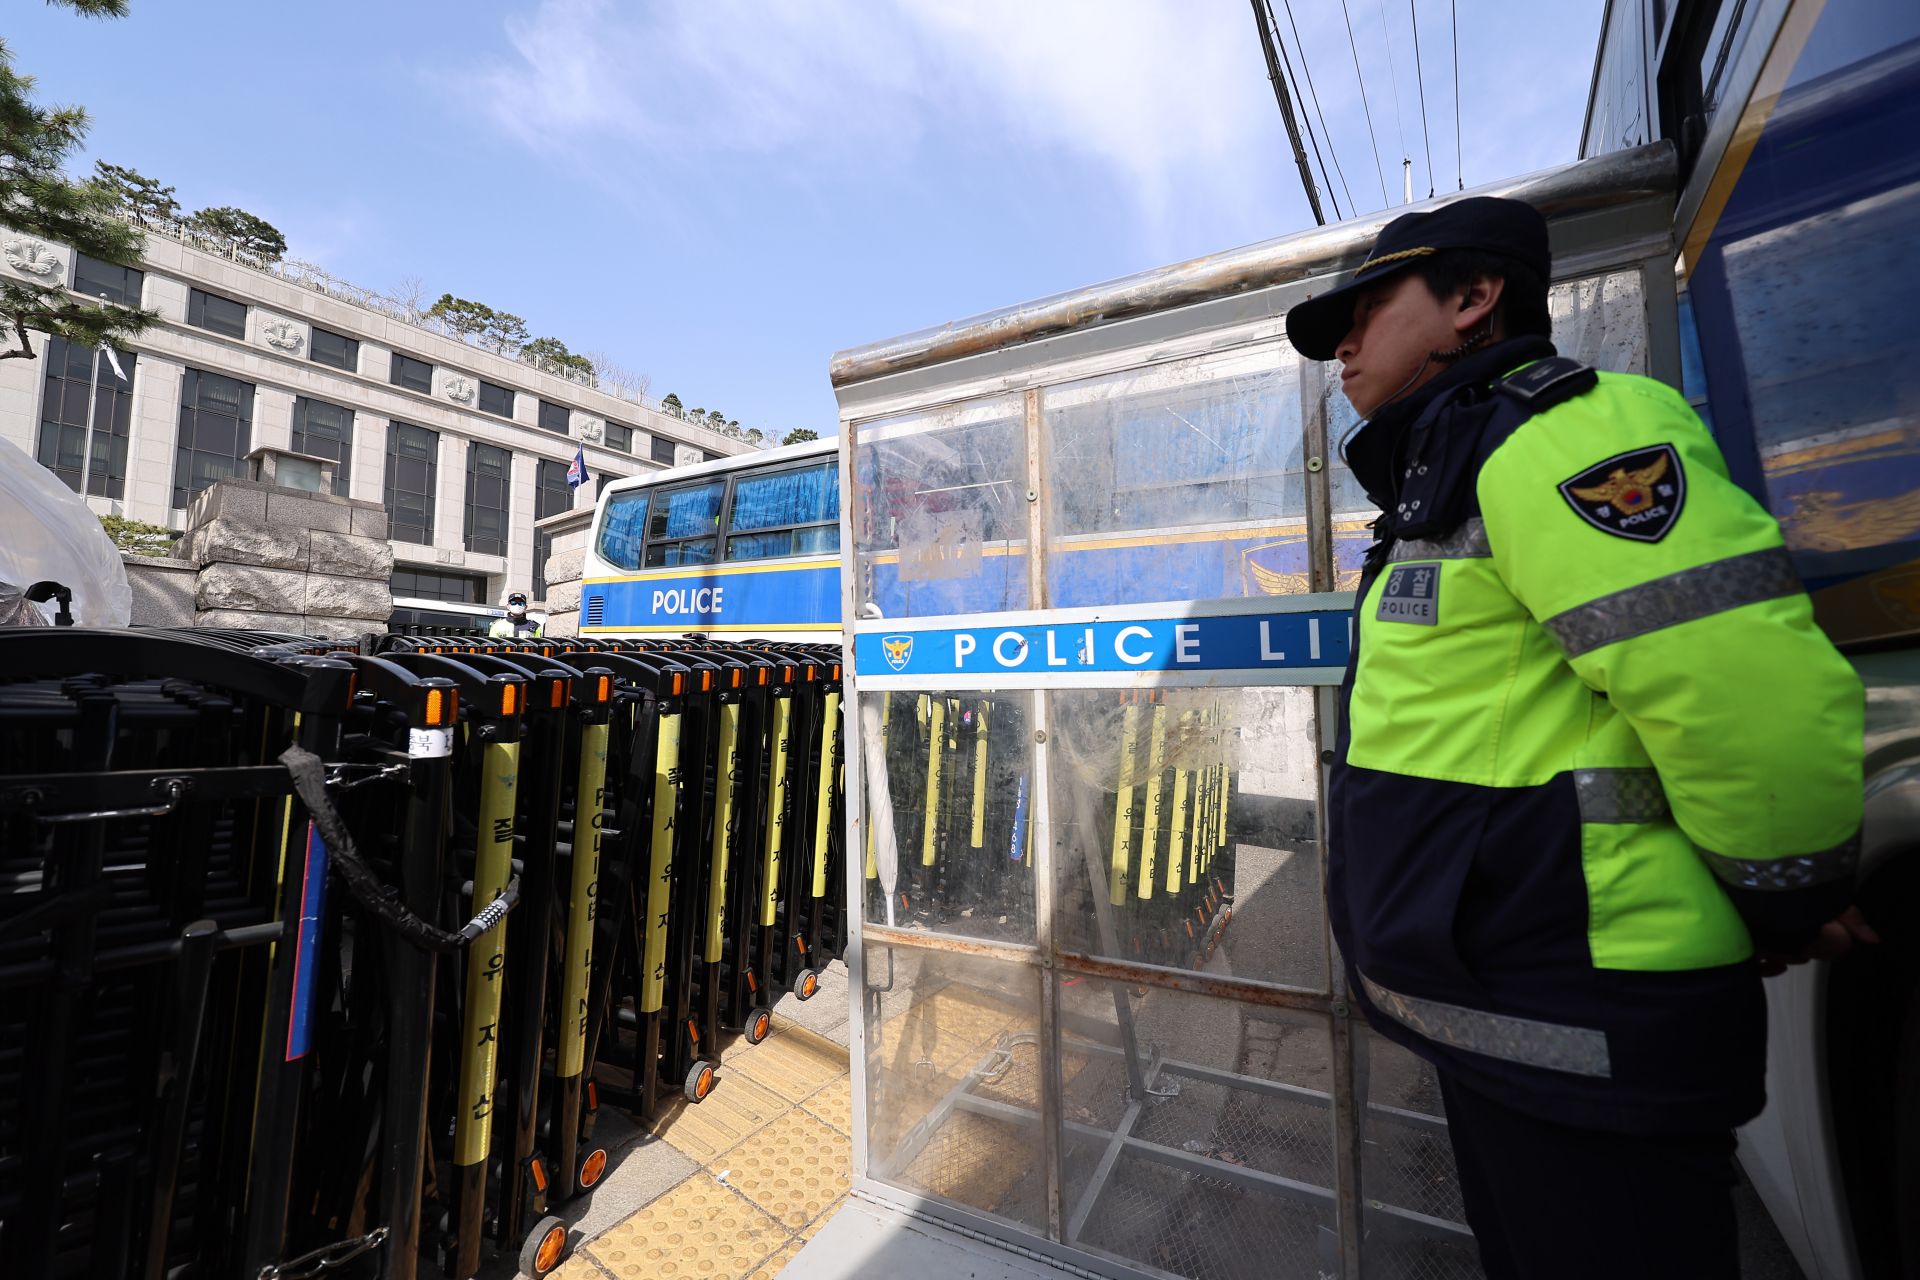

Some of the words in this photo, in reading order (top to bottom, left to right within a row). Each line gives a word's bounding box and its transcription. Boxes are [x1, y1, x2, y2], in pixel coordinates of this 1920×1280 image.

[1619, 504, 1669, 529] POLICE
[1388, 569, 1432, 597] 경찰
[652, 587, 723, 615] POLICE
[1380, 601, 1429, 617] POLICE
[955, 624, 1201, 668] POLICE
[1260, 616, 1353, 661] LI
[586, 786, 605, 922] POLICE
